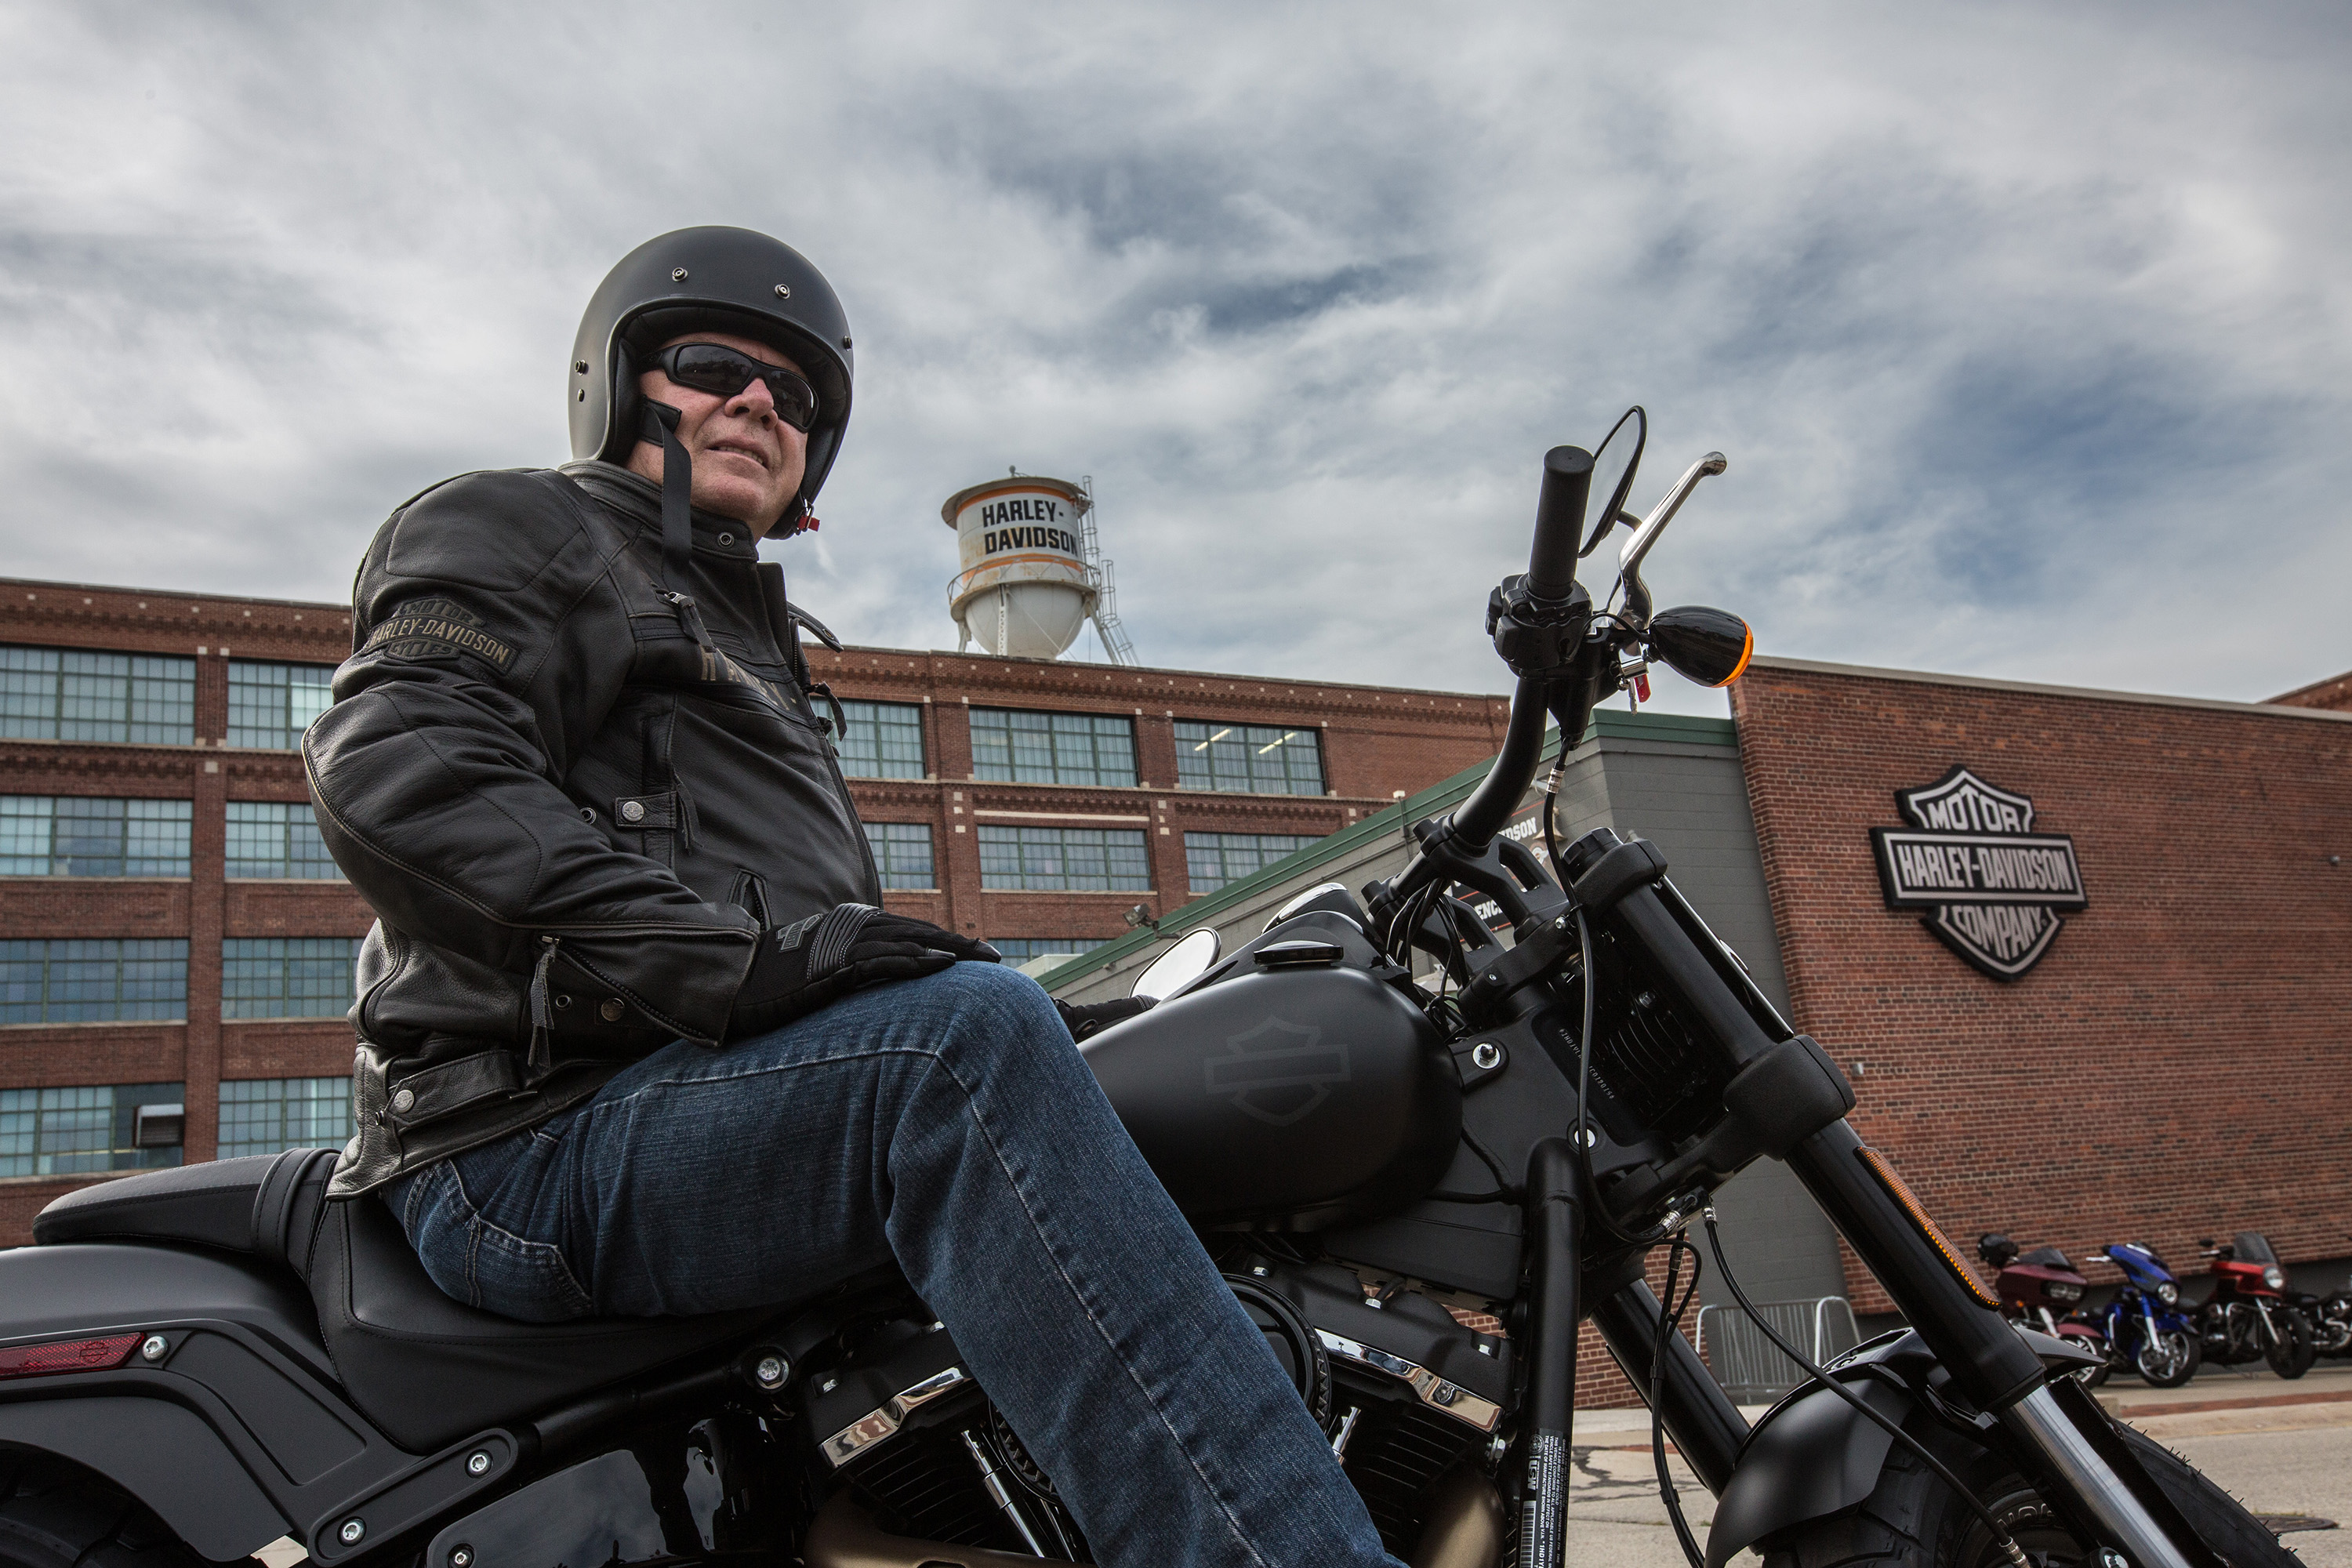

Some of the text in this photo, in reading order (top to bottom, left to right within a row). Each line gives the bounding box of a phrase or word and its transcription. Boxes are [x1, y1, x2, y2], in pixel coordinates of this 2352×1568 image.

[982, 499, 1064, 528] HARLEY-
[985, 526, 1078, 557] DAVIDSON
[405, 600, 474, 624] MOTOR
[368, 618, 510, 664] HARLEY-DAVIDSON
[1926, 784, 2022, 833] MOTOR
[1896, 844, 2074, 891] HARLEY-DAVIDSON
[1951, 906, 2042, 961] COMPANY
[1527, 1460, 1537, 1490] USW
